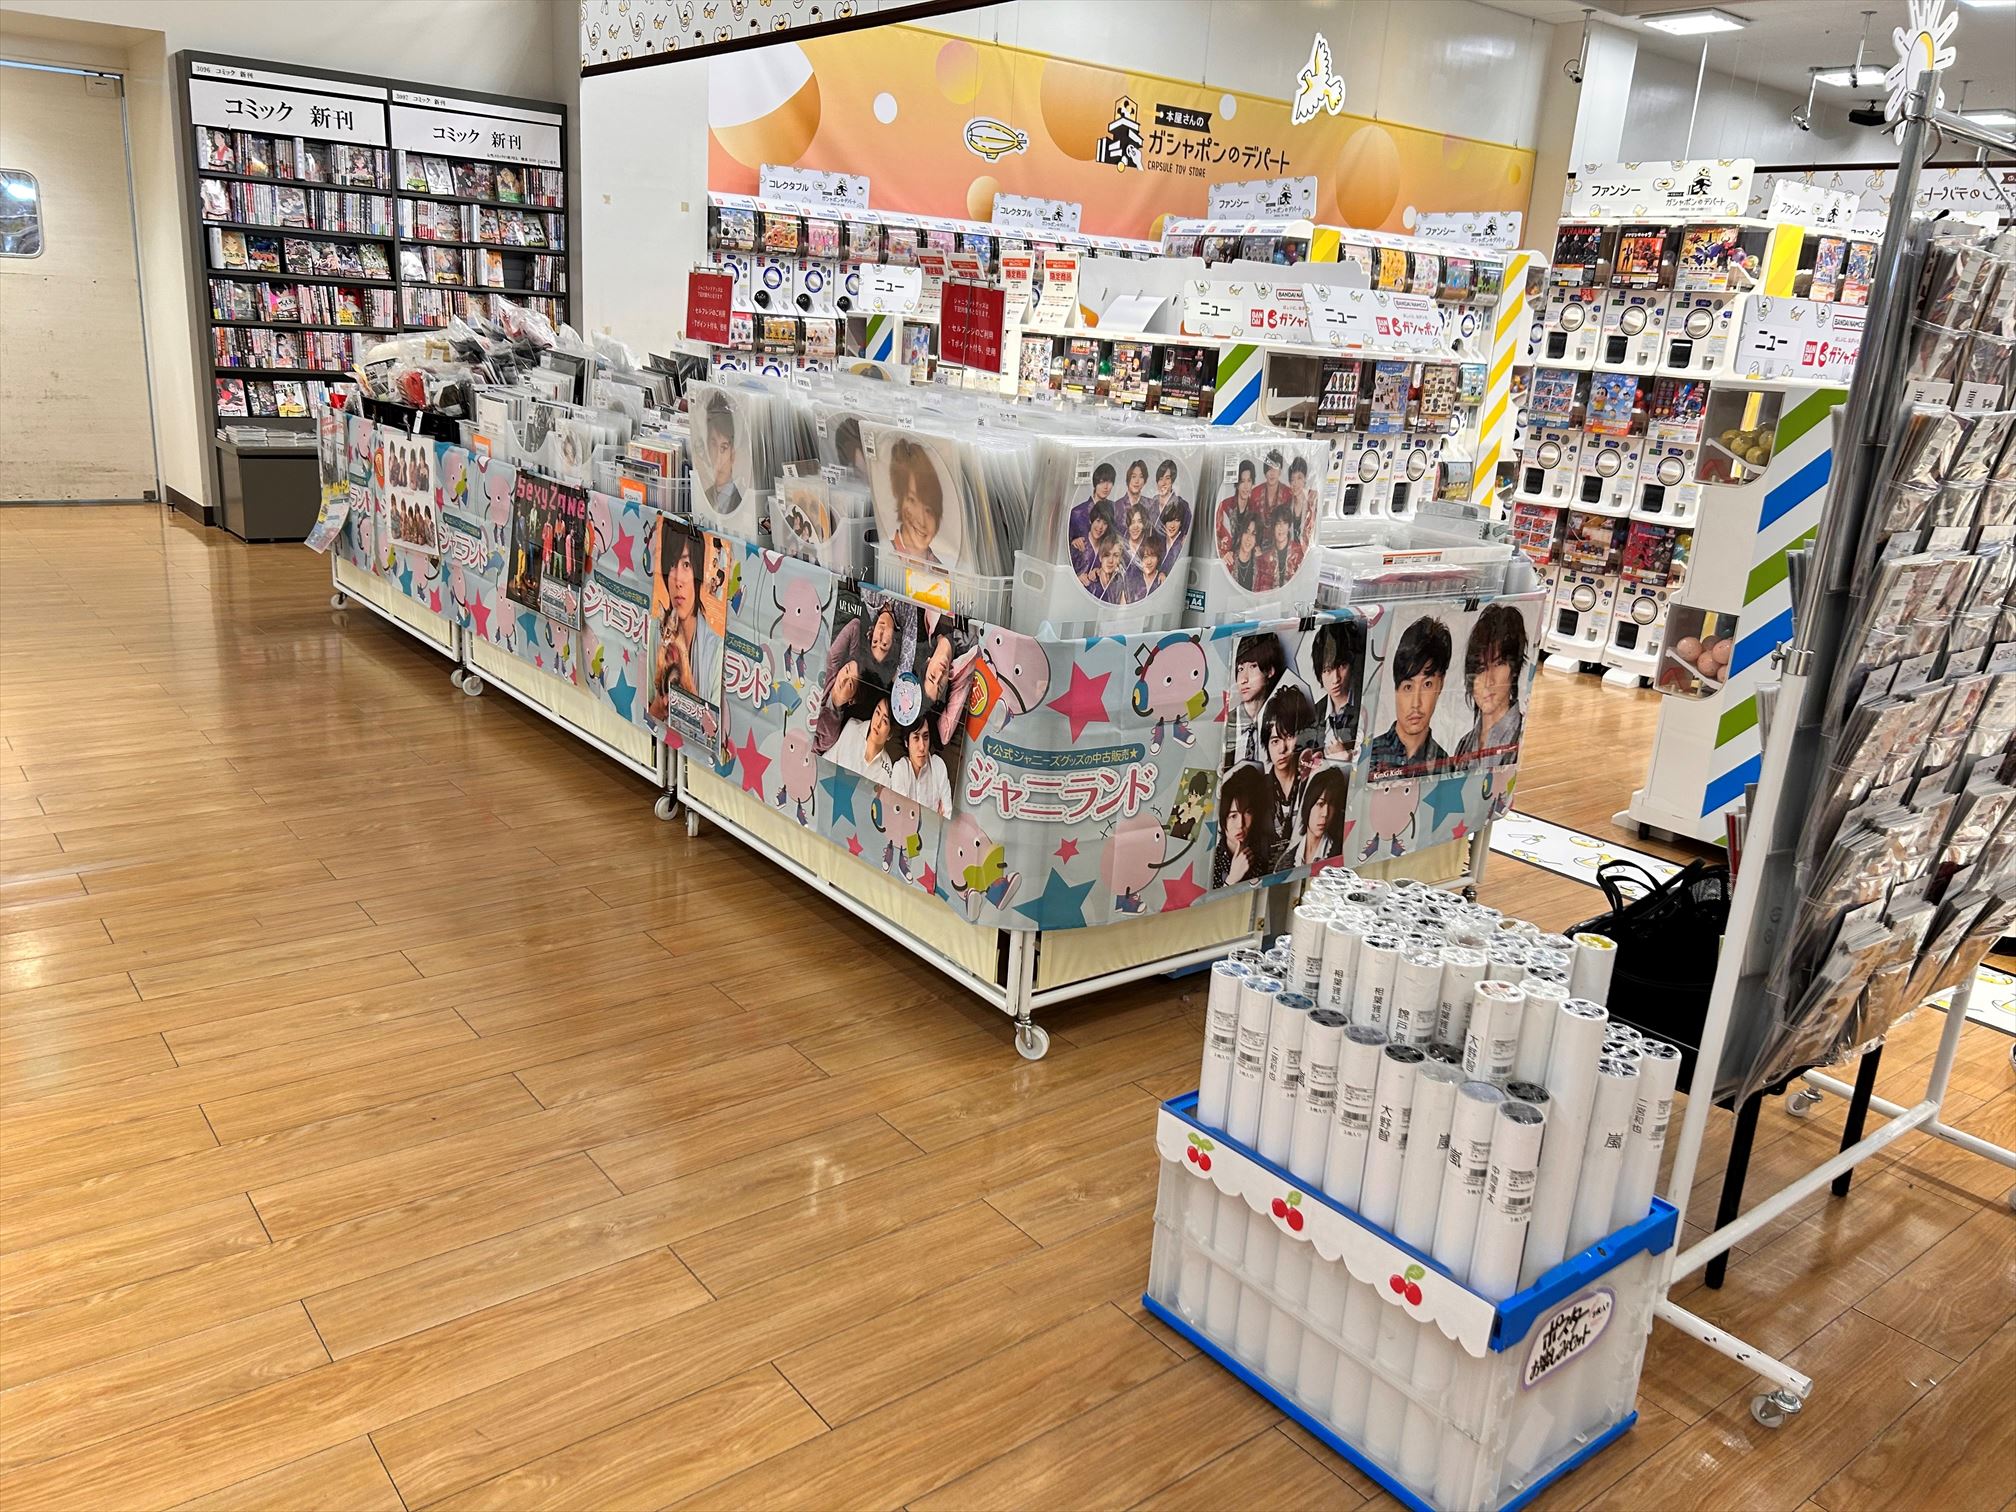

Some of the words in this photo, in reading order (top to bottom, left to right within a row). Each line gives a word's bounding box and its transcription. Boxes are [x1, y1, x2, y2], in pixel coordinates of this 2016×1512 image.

[225, 98, 293, 121] コミック
[310, 105, 353, 131] 新刊
[1166, 110, 1205, 127] 本屋さんの
[433, 126, 480, 144] コミック
[491, 131, 521, 150] 新刊
[1149, 130, 1290, 174] ガシャポンのデパート
[1147, 160, 1173, 172] CAPSULE
[1176, 165, 1187, 175] TOY
[1189, 167, 1206, 178] STORE
[769, 180, 809, 192] コレクタブル
[1592, 184, 1641, 197] ファンシー
[1000, 207, 1032, 217] コレクタブル
[1219, 199, 1249, 208] ファンシー
[1781, 202, 1806, 215] ファンシー
[1426, 227, 1455, 236] ファンシー
[875, 280, 904, 292] ニュー
[1200, 302, 1231, 316] ニュー
[1325, 308, 1357, 324] ニュー
[1755, 331, 1788, 351] ニュー
[516, 475, 548, 511] Sexy
[1191, 598, 1202, 607] A4
[993, 744, 1131, 767] 公式ジャニーズグッズの中古販売
[1373, 770, 1389, 780] KinKi
[1389, 768, 1403, 778] Kids
[967, 754, 1157, 823] ジャニランド
[1466, 1034, 1479, 1073] 大野智
[1378, 1104, 1393, 1142] 大野智
[1604, 1132, 1624, 1149] 嵐
